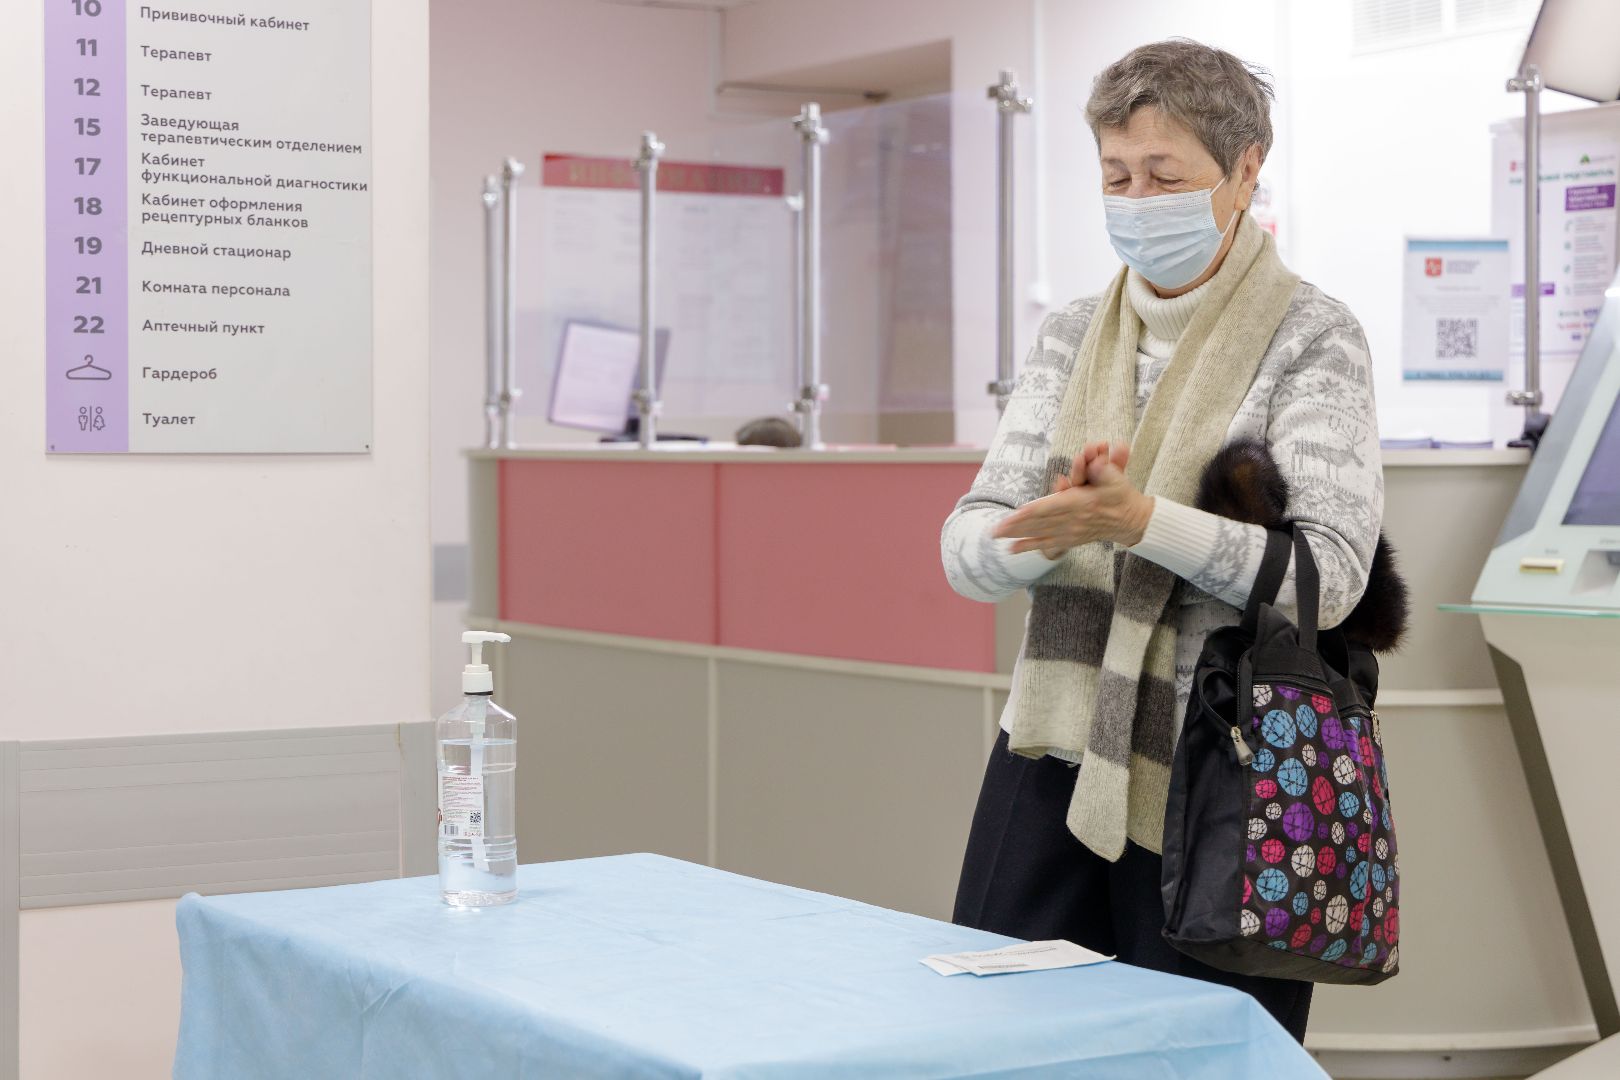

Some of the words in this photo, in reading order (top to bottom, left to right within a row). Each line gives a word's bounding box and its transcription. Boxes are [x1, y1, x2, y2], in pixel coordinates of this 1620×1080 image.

[71, 0, 102, 17] 10
[140, 5, 246, 26] Прививочный
[250, 16, 310, 31] кабинет
[76, 38, 97, 57] 11
[140, 45, 213, 62] Терапевт
[73, 77, 101, 97] 12
[140, 84, 213, 101] Терапевт
[74, 117, 101, 137] 15
[140, 113, 240, 133] Заведующая
[140, 132, 272, 149] терапевтическим
[276, 139, 362, 154] отделением
[74, 157, 102, 176] 17
[141, 152, 206, 168] Кабинет
[141, 168, 272, 187] функциональной
[276, 178, 368, 192] диагностики
[73, 196, 103, 216] 18
[141, 192, 206, 208] Кабинет
[209, 196, 303, 213] оформления
[141, 211, 243, 227] рецептурных
[246, 213, 309, 229] бланков
[74, 236, 103, 255] 19
[141, 240, 209, 256] Дневной
[212, 246, 292, 262] стационар
[75, 275, 102, 295] 21
[142, 280, 208, 294] Комната
[211, 285, 291, 298] персонала
[73, 315, 105, 334] 22
[141, 319, 218, 333] Аптечный
[222, 324, 265, 337] пункт
[142, 366, 218, 383] Гардероб
[141, 412, 196, 428] Туалет
